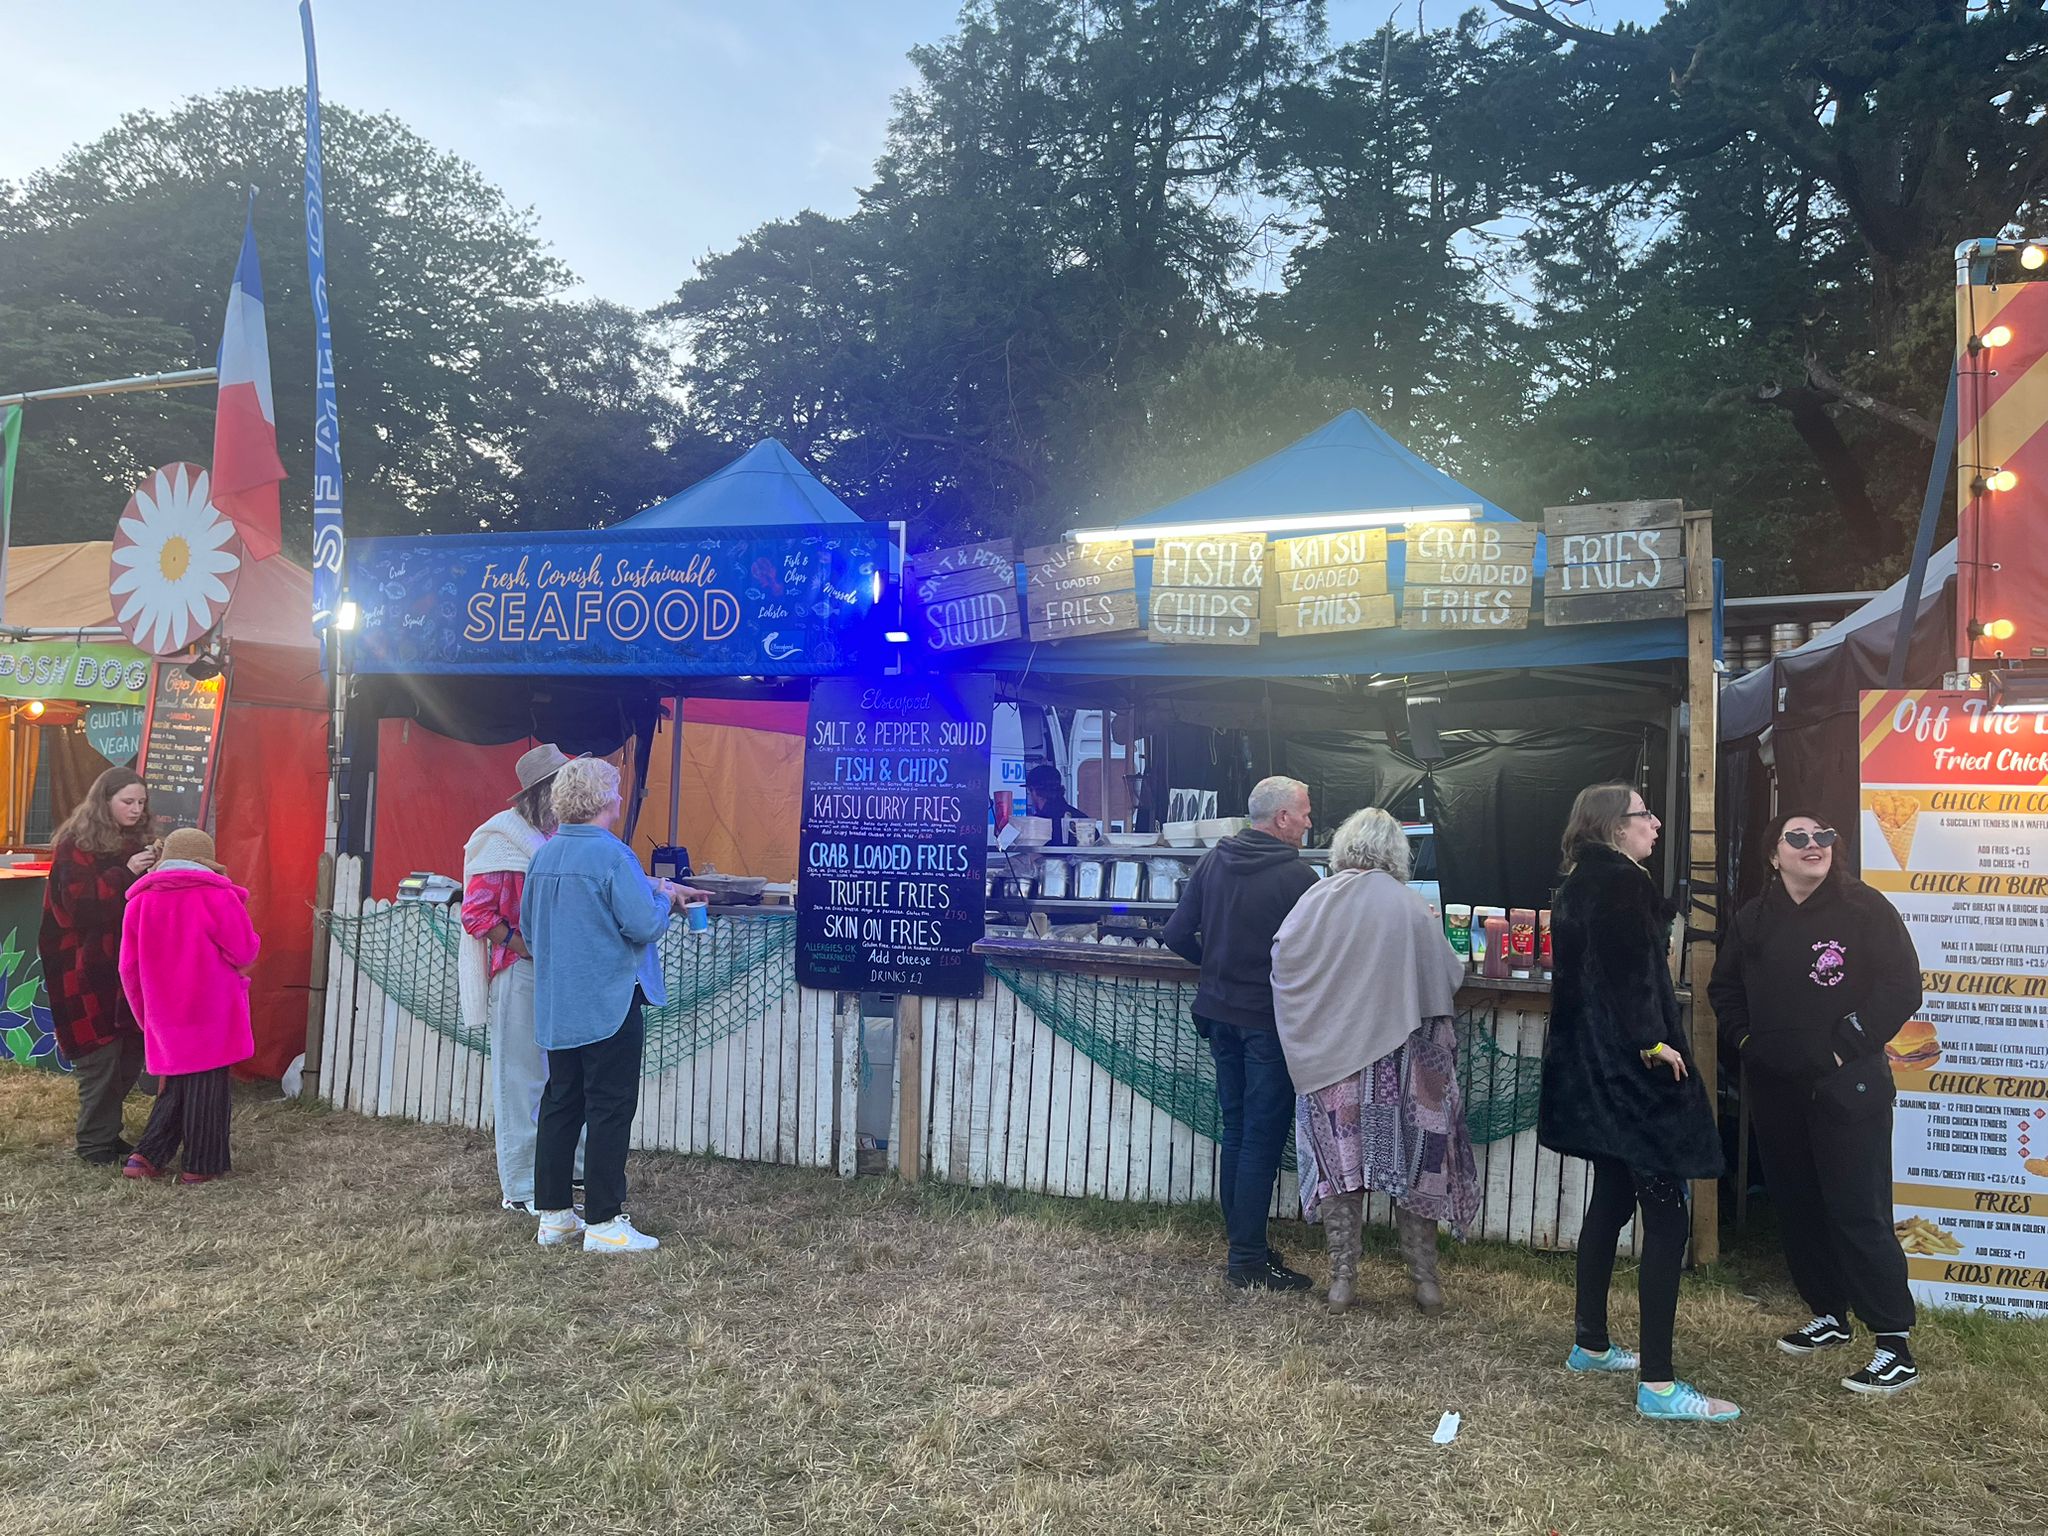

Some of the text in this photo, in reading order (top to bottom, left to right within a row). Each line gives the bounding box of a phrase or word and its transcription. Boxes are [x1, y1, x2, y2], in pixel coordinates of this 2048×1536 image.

[1290, 529, 1366, 570] KATSU
[1418, 526, 1501, 561] CRAB
[611, 553, 717, 588] Sustainable
[784, 551, 808, 568] Fish &
[1032, 542, 1123, 587] TRUFFLE
[1163, 541, 1264, 587] FISH &
[1561, 531, 1662, 591] FRIES
[784, 568, 808, 584] Chips
[919, 547, 1015, 602] SALT & PEPPER
[1056, 575, 1102, 591] LOADED
[1292, 568, 1359, 591] LOADED
[1440, 560, 1527, 585] LOADED
[823, 582, 858, 605] Mussels
[464, 589, 740, 642] SEAFOOD
[758, 604, 788, 619] Lobster
[1046, 595, 1115, 630] FRIES
[1153, 592, 1252, 637] CHIPS
[1297, 594, 1361, 628] FRIES
[1421, 587, 1511, 625] FRIES
[74, 656, 147, 691] DOG
[89, 709, 128, 730] GLUTEN
[1893, 699, 1950, 742] Off
[813, 721, 986, 746] SALT & PEPPER SQUID
[100, 736, 139, 755] VEGAN
[835, 757, 949, 783] FISH & CHIPS
[1933, 747, 1992, 771] Fried
[814, 794, 961, 823] KATSU CURRY FRIES
[1931, 792, 1991, 810] CHICK
[1946, 819, 1981, 827] SUCCULENT
[1983, 819, 2009, 828] TENDERS
[2011, 820, 2019, 828] IN
[2020, 820, 2024, 828] A
[809, 842, 968, 871] CRAB LOADED FRIES
[1978, 845, 1990, 854] ADD
[1992, 846, 2009, 855] FRIES
[1979, 859, 1991, 868] ADD
[1993, 859, 2015, 868] CHEESE
[829, 880, 950, 909] TRUFFLE FRIES
[1910, 872, 1971, 892] CHICK
[1976, 876, 2000, 894] IN
[1952, 902, 1970, 911] JUICY
[1972, 902, 1996, 912] BREAST
[1998, 904, 2005, 912] IN
[2006, 904, 2011, 912] A
[2013, 904, 2038, 913] BRIOCHE
[824, 915, 941, 945] SKIN ON FRIES
[1912, 914, 1929, 923] WITH
[1930, 915, 1952, 924] CRISPY
[1954, 915, 1983, 926] LETTUCE,
[1984, 917, 2003, 926] FRESH
[2005, 917, 2017, 926] RED
[2018, 918, 2038, 927] ONION
[2040, 919, 2044, 927] &
[868, 949, 890, 963] Add
[897, 951, 931, 965] cheese
[1941, 941, 1960, 950] MAKE
[1961, 942, 1968, 951] IT
[1969, 943, 1974, 951] A
[1975, 942, 1998, 952] DOUBLE
[2000, 943, 2024, 953] (EXTRA
[1945, 955, 1957, 964] ADD
[1959, 956, 2004, 966] FRIES/CHEESY
[2006, 957, 2023, 966] FRIES
[870, 969, 923, 984] DRINKS £2
[1956, 974, 2018, 994] CHICK
[1929, 1073, 2048, 1098] CHICK TEND
[1900, 1099, 1926, 1110] SHARING
[1928, 1100, 1940, 1110] BOX
[1948, 1102, 1955, 1111] 12
[1956, 1103, 1973, 1113] FRIED
[1975, 1104, 2001, 1114] CHICKEN
[2003, 1106, 2030, 1117] TENDERS
[1927, 1115, 2007, 1129] 7 FRIED CHICKEN TENDERS
[1974, 1191, 2031, 1213] FRIES
[1938, 1217, 2045, 1234] LARGE PORTION OF SKIN ON GOLDEN
[1976, 1247, 1987, 1256] ADD
[1989, 1248, 2011, 1259] CHEESE
[1944, 1263, 2048, 1289] KIDS MEA
[1945, 1292, 1949, 1300] 2
[1951, 1292, 1978, 1304] TENDERS
[1979, 1295, 1983, 1304] &
[1985, 1296, 2006, 1306] SMALL
[2008, 1298, 2034, 1308] PORTION
